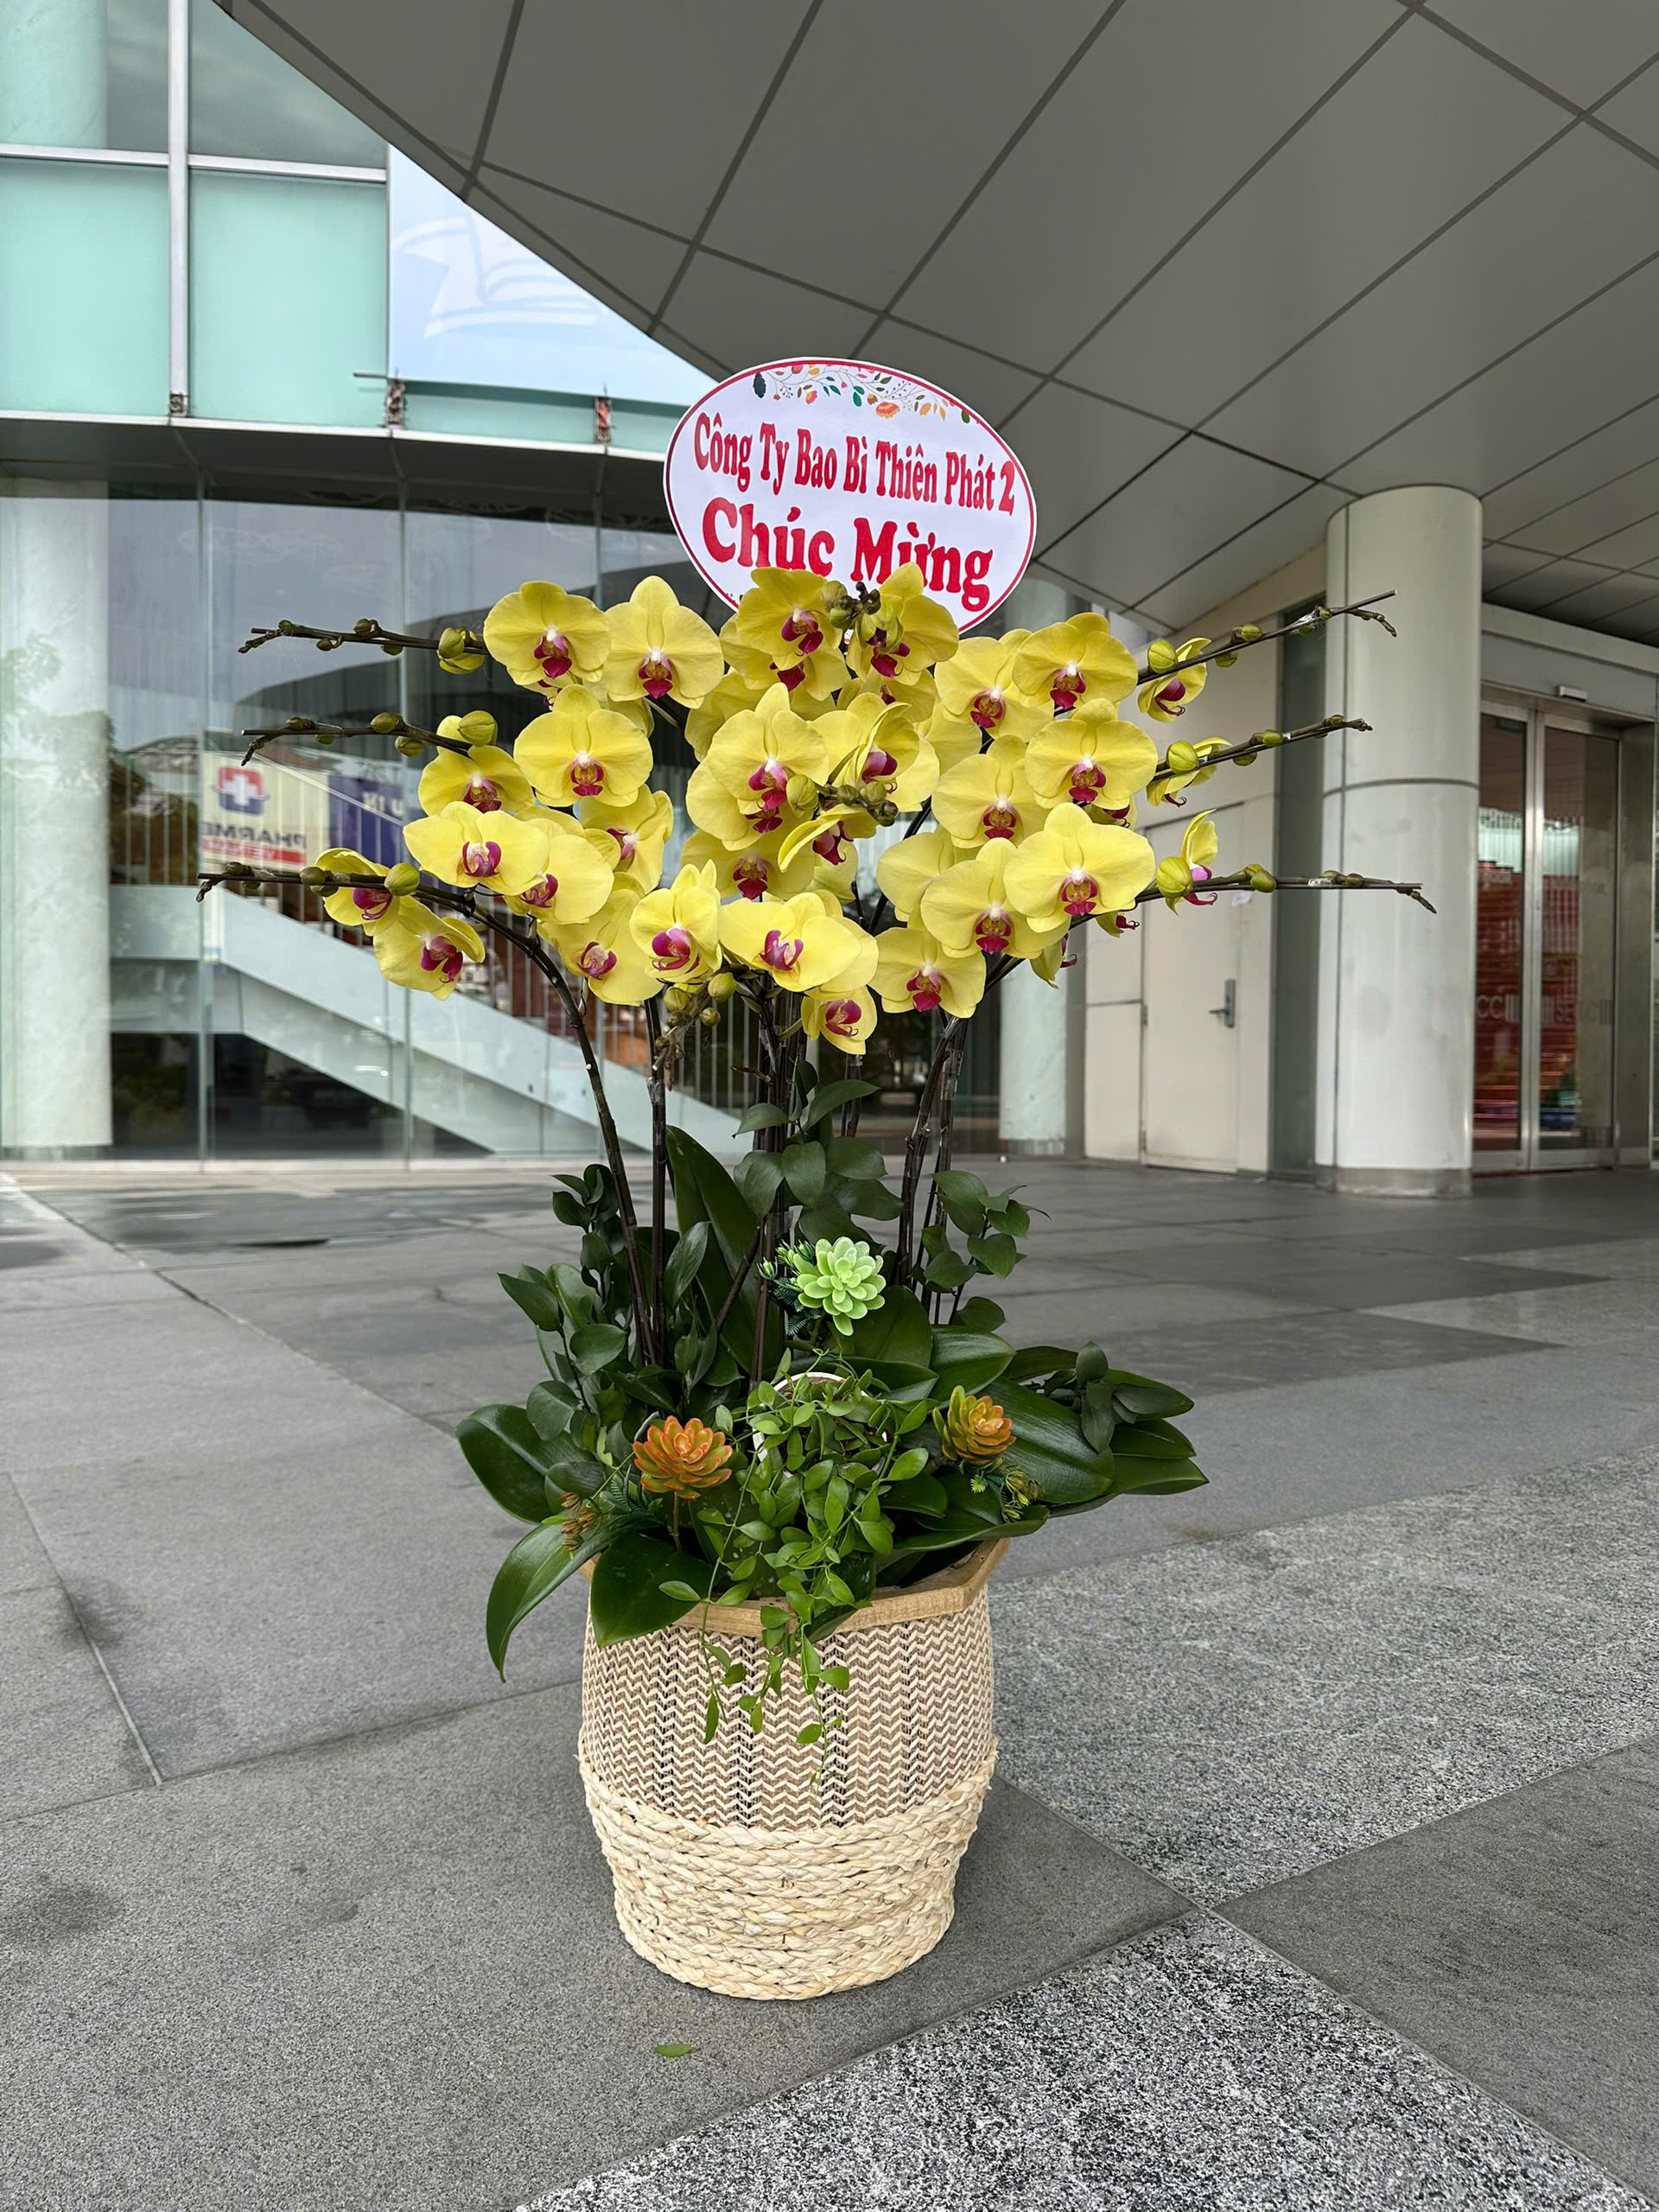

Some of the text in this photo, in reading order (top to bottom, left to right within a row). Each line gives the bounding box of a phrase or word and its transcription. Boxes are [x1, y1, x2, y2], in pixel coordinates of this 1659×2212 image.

[694, 411, 1015, 517] Công Ty Bao Bì Thiên Phát 2
[702, 497, 994, 613] Chúc Mừng
